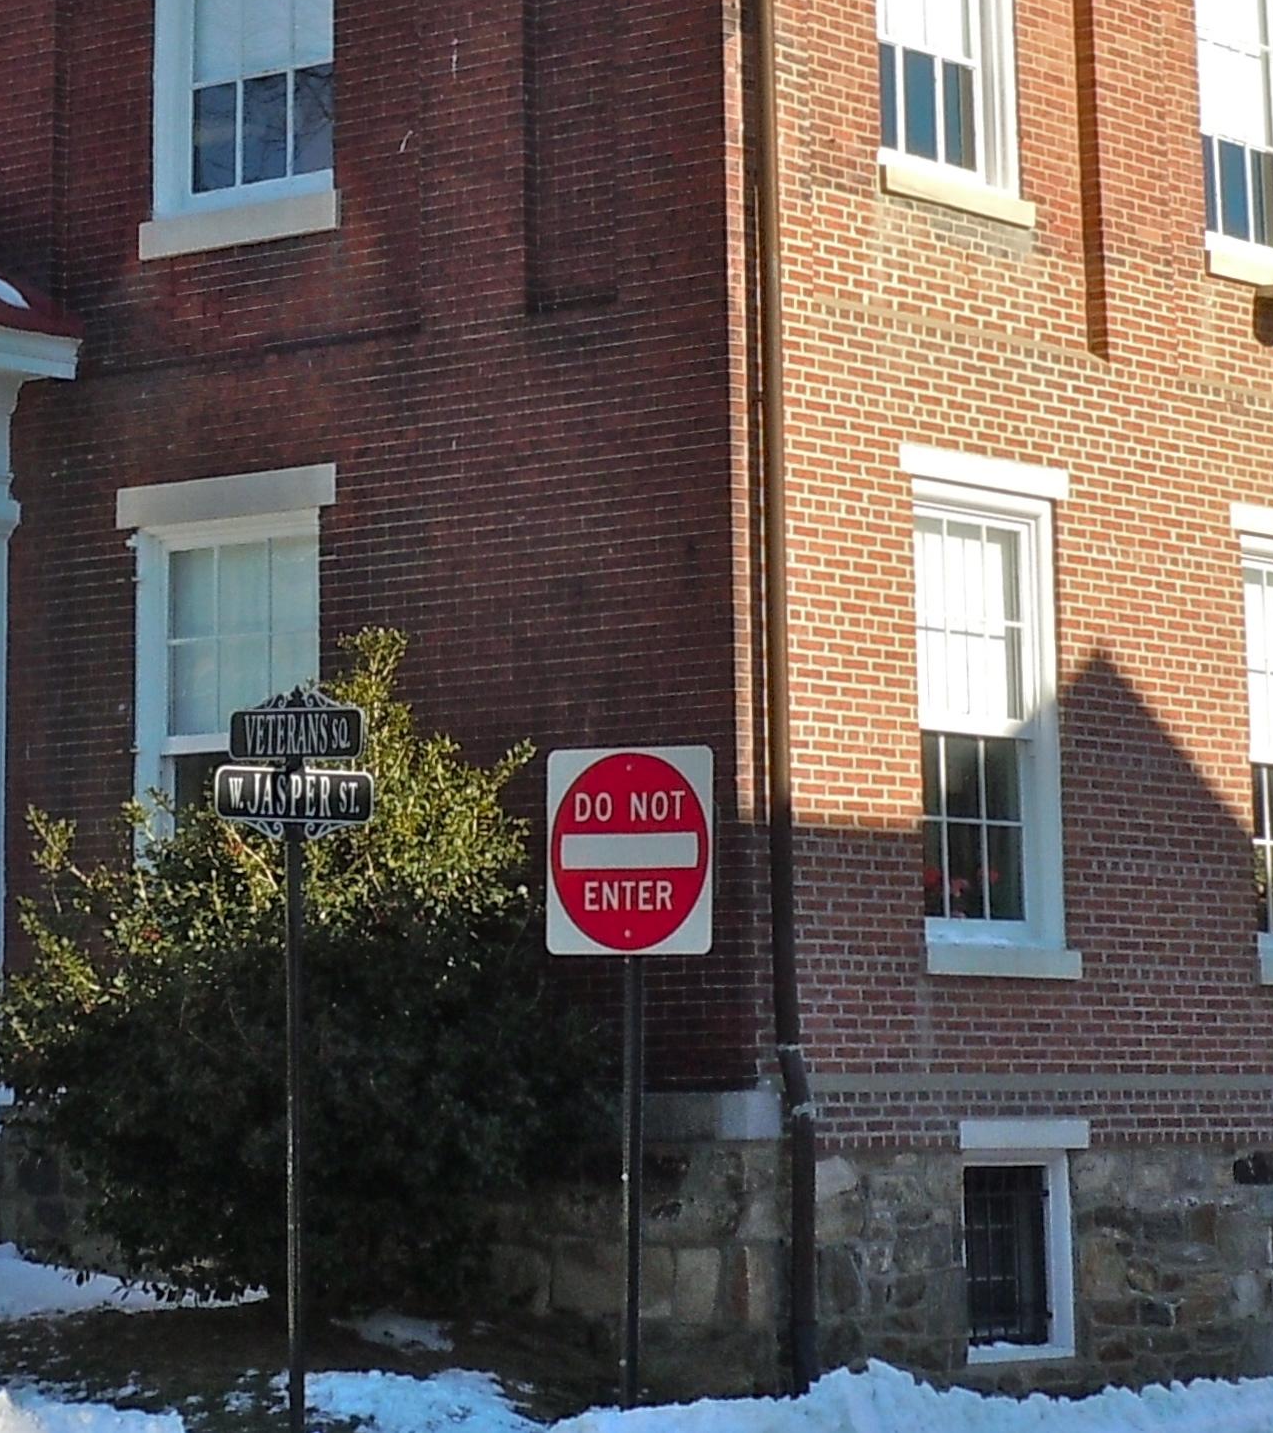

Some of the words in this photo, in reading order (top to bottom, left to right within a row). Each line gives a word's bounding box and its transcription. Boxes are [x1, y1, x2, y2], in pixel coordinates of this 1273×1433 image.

[244, 713, 328, 755] VETERANS
[229, 776, 244, 810] W.
[247, 773, 332, 817] JASPER
[338, 781, 360, 814] ST.
[575, 791, 613, 822] DO
[630, 790, 686, 821] NOT
[584, 880, 673, 911] ENTER
